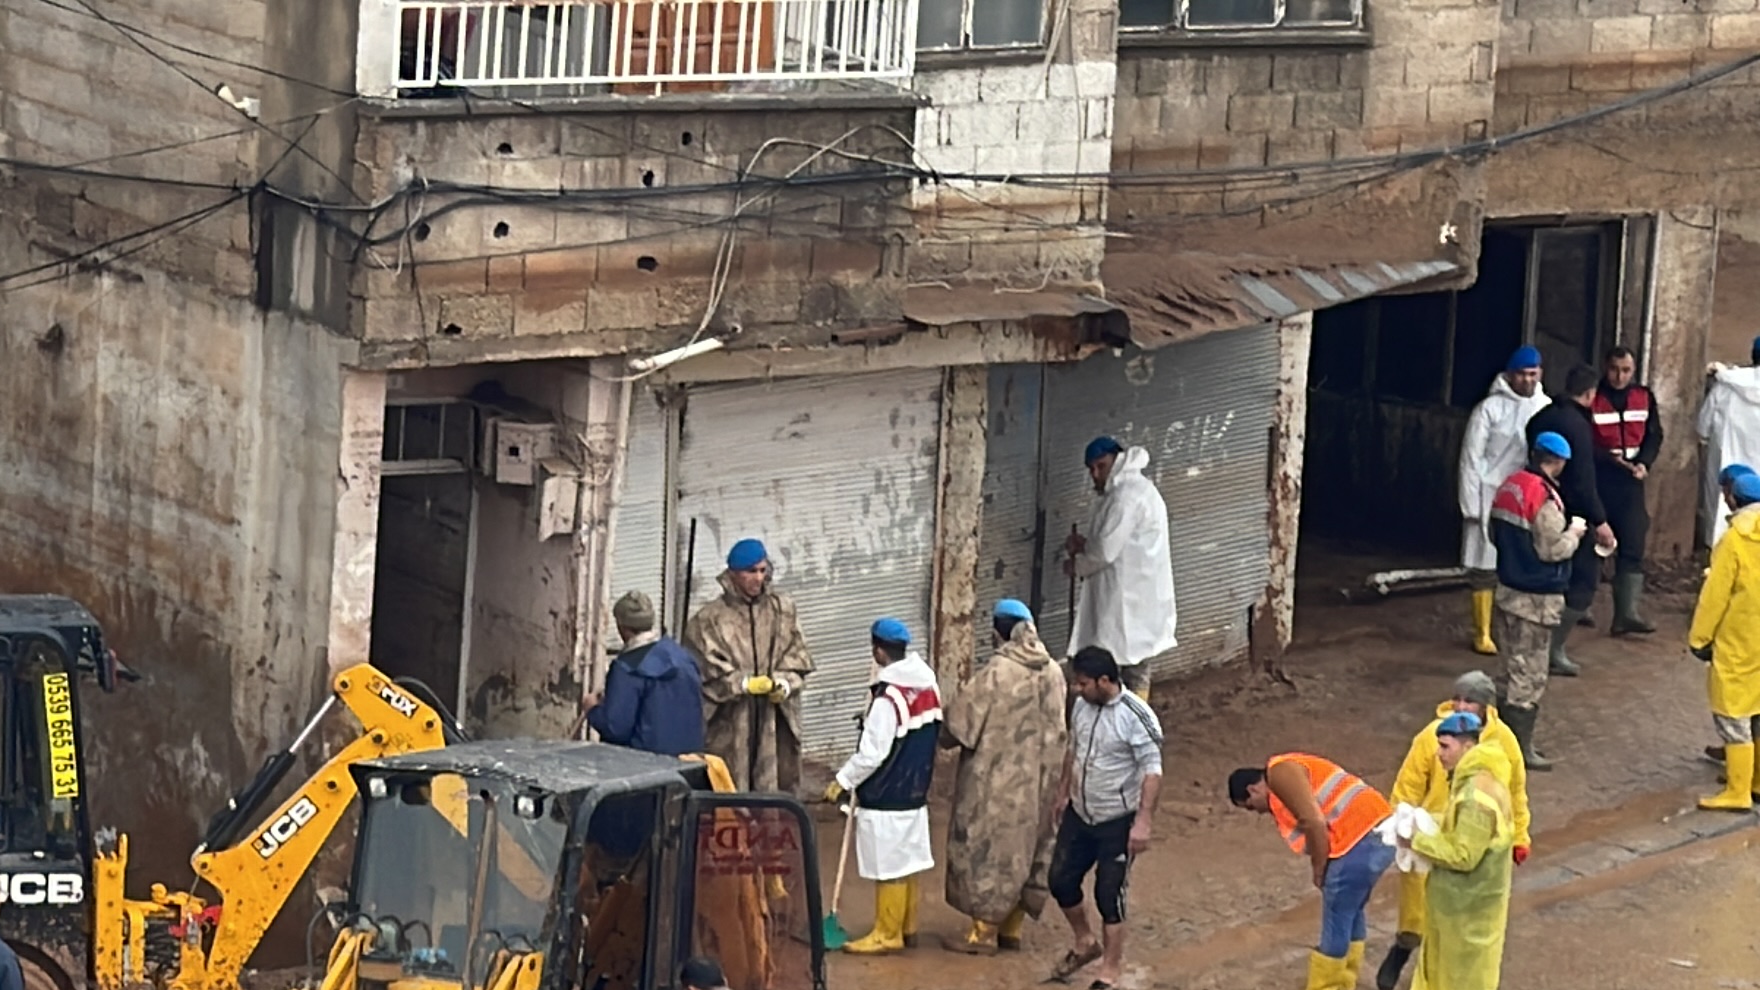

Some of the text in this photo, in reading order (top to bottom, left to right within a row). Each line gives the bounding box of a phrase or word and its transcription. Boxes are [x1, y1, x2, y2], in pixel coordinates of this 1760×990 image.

[46, 675, 77, 796] 0539 665 75 31
[259, 797, 318, 858] JCB
